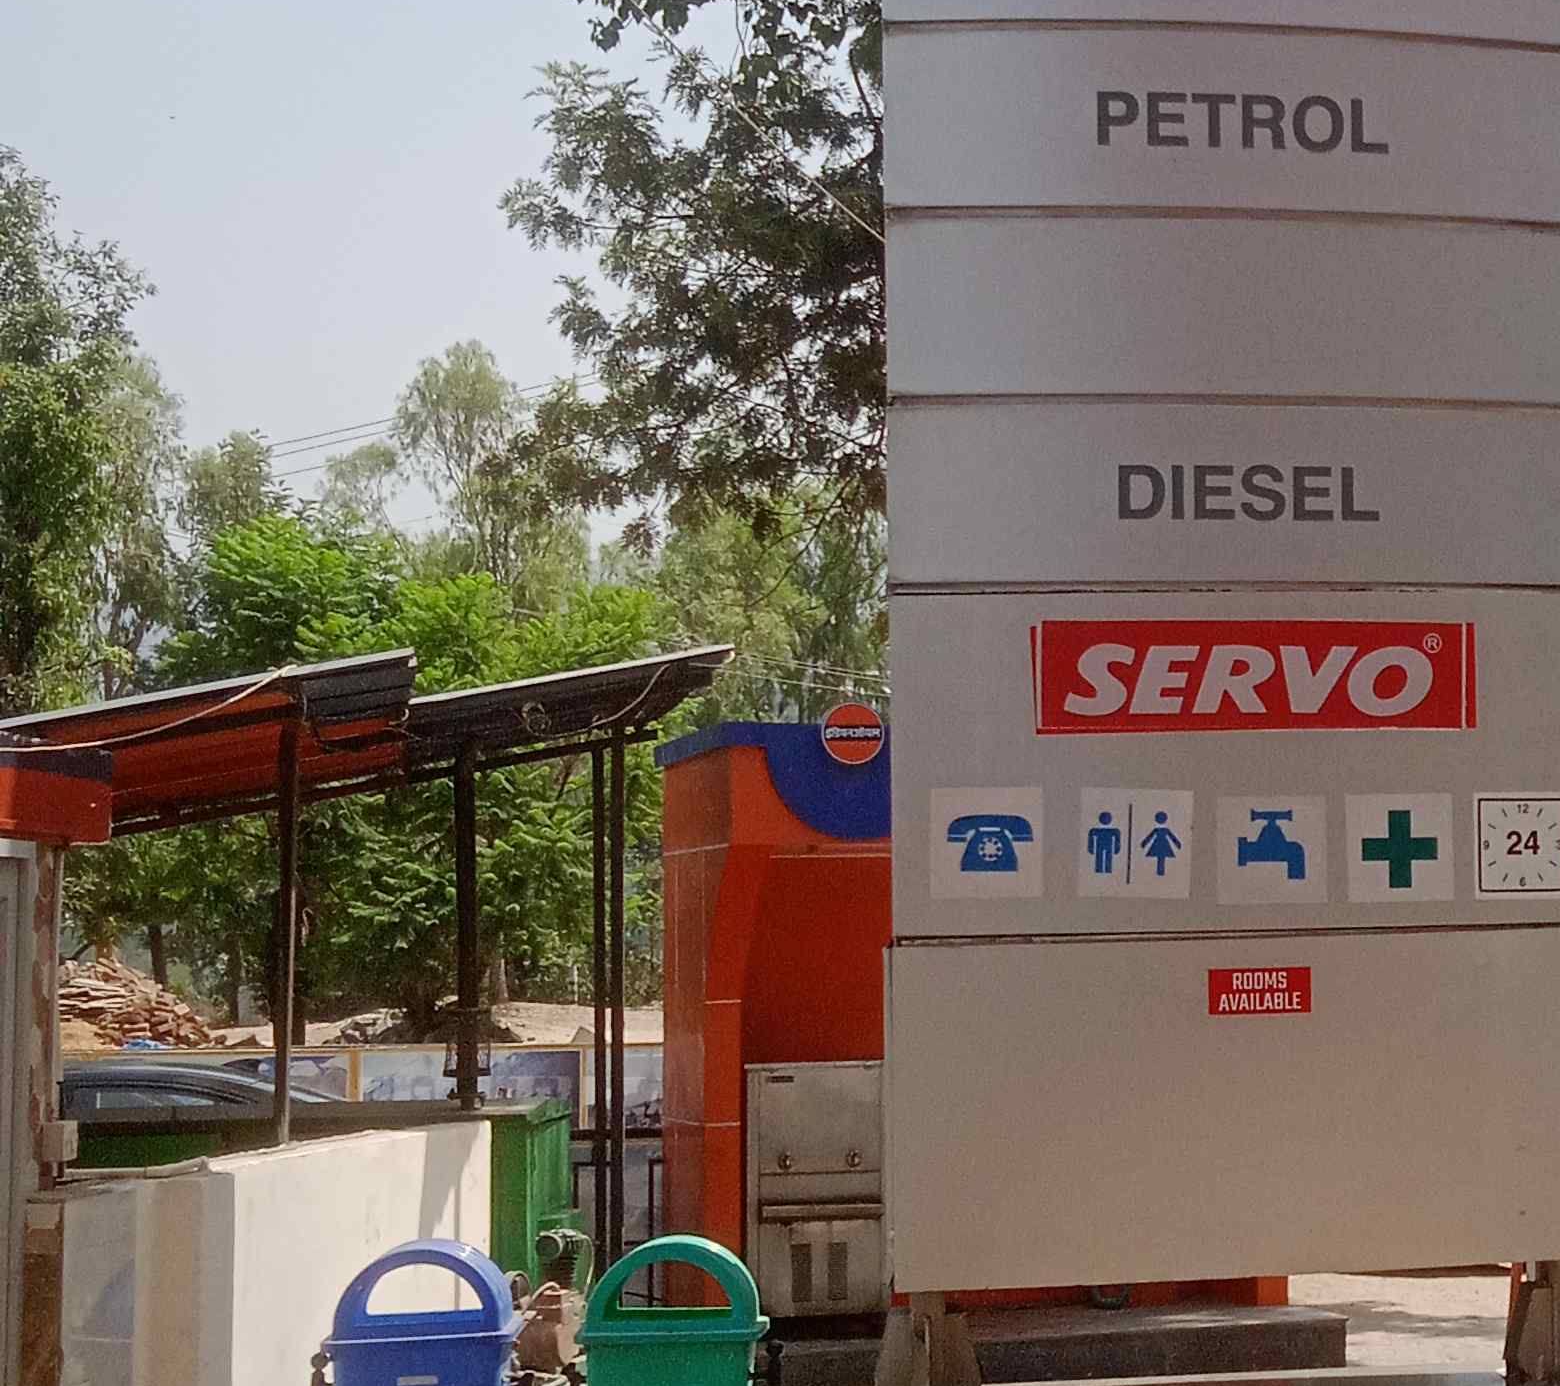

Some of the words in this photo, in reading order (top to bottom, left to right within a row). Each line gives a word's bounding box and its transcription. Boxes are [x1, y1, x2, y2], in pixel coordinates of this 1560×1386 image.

[1096, 90, 1390, 155] PETROL
[1116, 463, 1381, 523] DIESEL
[1516, 803, 1529, 814] 12
[1482, 839, 1491, 851] 9
[1506, 830, 1540, 855] 24
[1519, 876, 1527, 887] 6
[1231, 971, 1288, 990] ROOMS
[1218, 991, 1303, 1011] AVAILABLE
